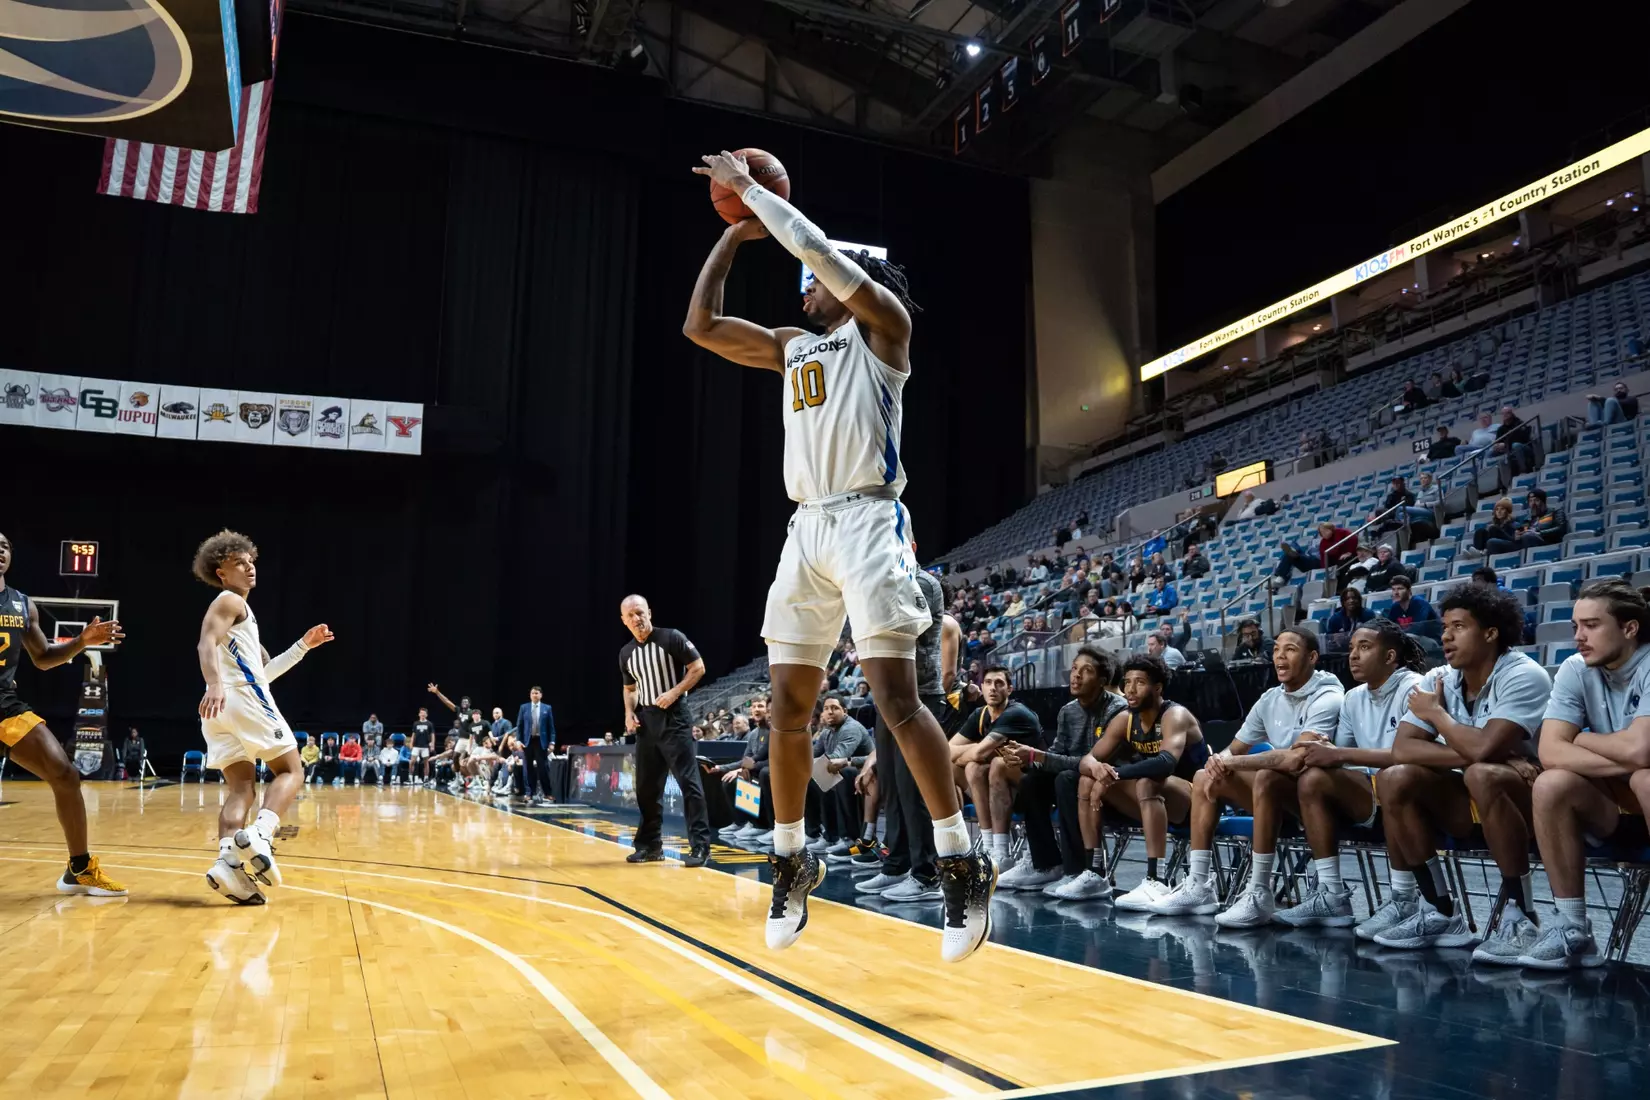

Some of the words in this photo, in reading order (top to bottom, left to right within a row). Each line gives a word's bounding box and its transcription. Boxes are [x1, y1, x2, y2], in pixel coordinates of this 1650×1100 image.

[1068, 18, 1079, 45] 11
[1008, 79, 1014, 100] 5
[982, 102, 990, 122] 2
[961, 124, 967, 144] 1
[1410, 237, 1431, 254] Fort
[1433, 216, 1479, 243] Wayne's
[1499, 184, 1548, 213] Country
[1552, 159, 1601, 189] Station
[1199, 336, 1214, 350] Fort
[1215, 324, 1245, 343] Waynes
[1257, 305, 1288, 324] Country
[1290, 289, 1320, 309] Station
[791, 360, 827, 413] 10
[80, 389, 119, 418] GB
[118, 409, 156, 425] IUPUI
[160, 411, 196, 421] MILWAUKEE
[387, 416, 421, 437] Y
[1415, 439, 1430, 452] 216
[72, 544, 95, 555] 9:53
[74, 555, 91, 571] 11
